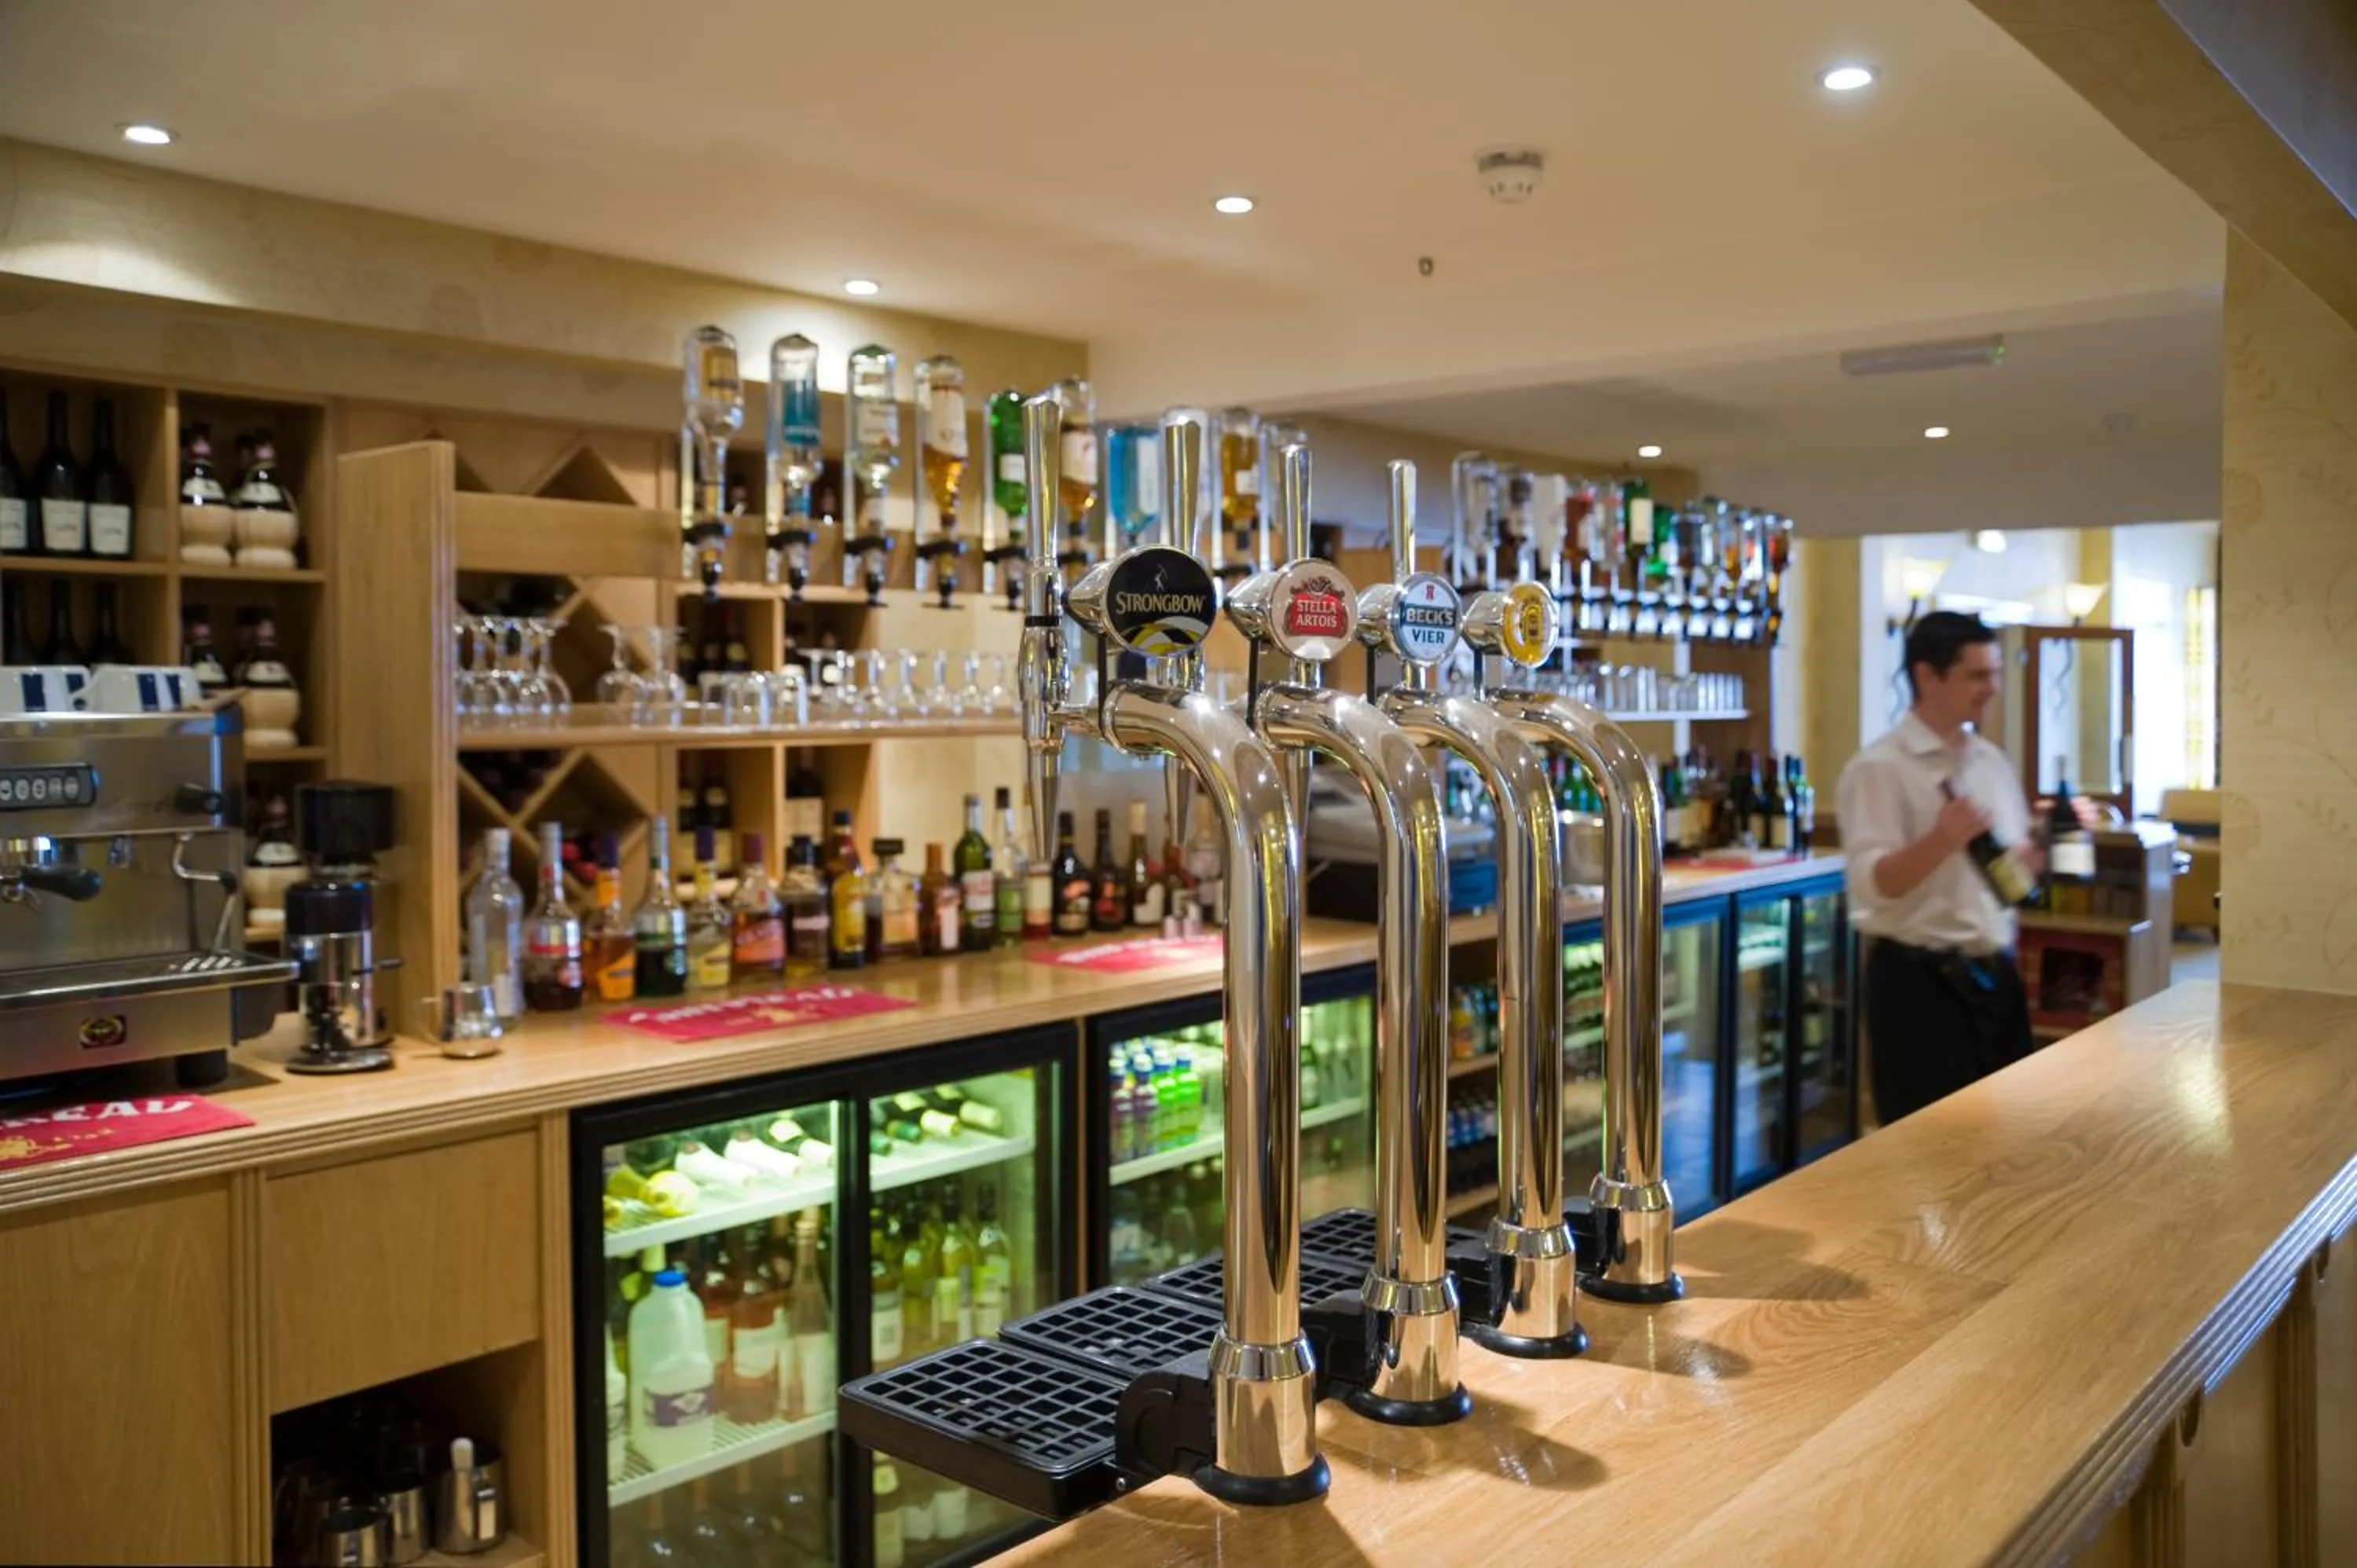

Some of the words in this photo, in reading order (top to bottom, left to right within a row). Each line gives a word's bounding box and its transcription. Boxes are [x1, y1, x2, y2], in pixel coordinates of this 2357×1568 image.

[1116, 591, 1206, 614] STRONGBOW
[1296, 599, 1337, 614] STELLA
[1295, 614, 1338, 628] ARTOIS
[1406, 607, 1453, 626] BECK'S
[1411, 628, 1446, 643] VIER
